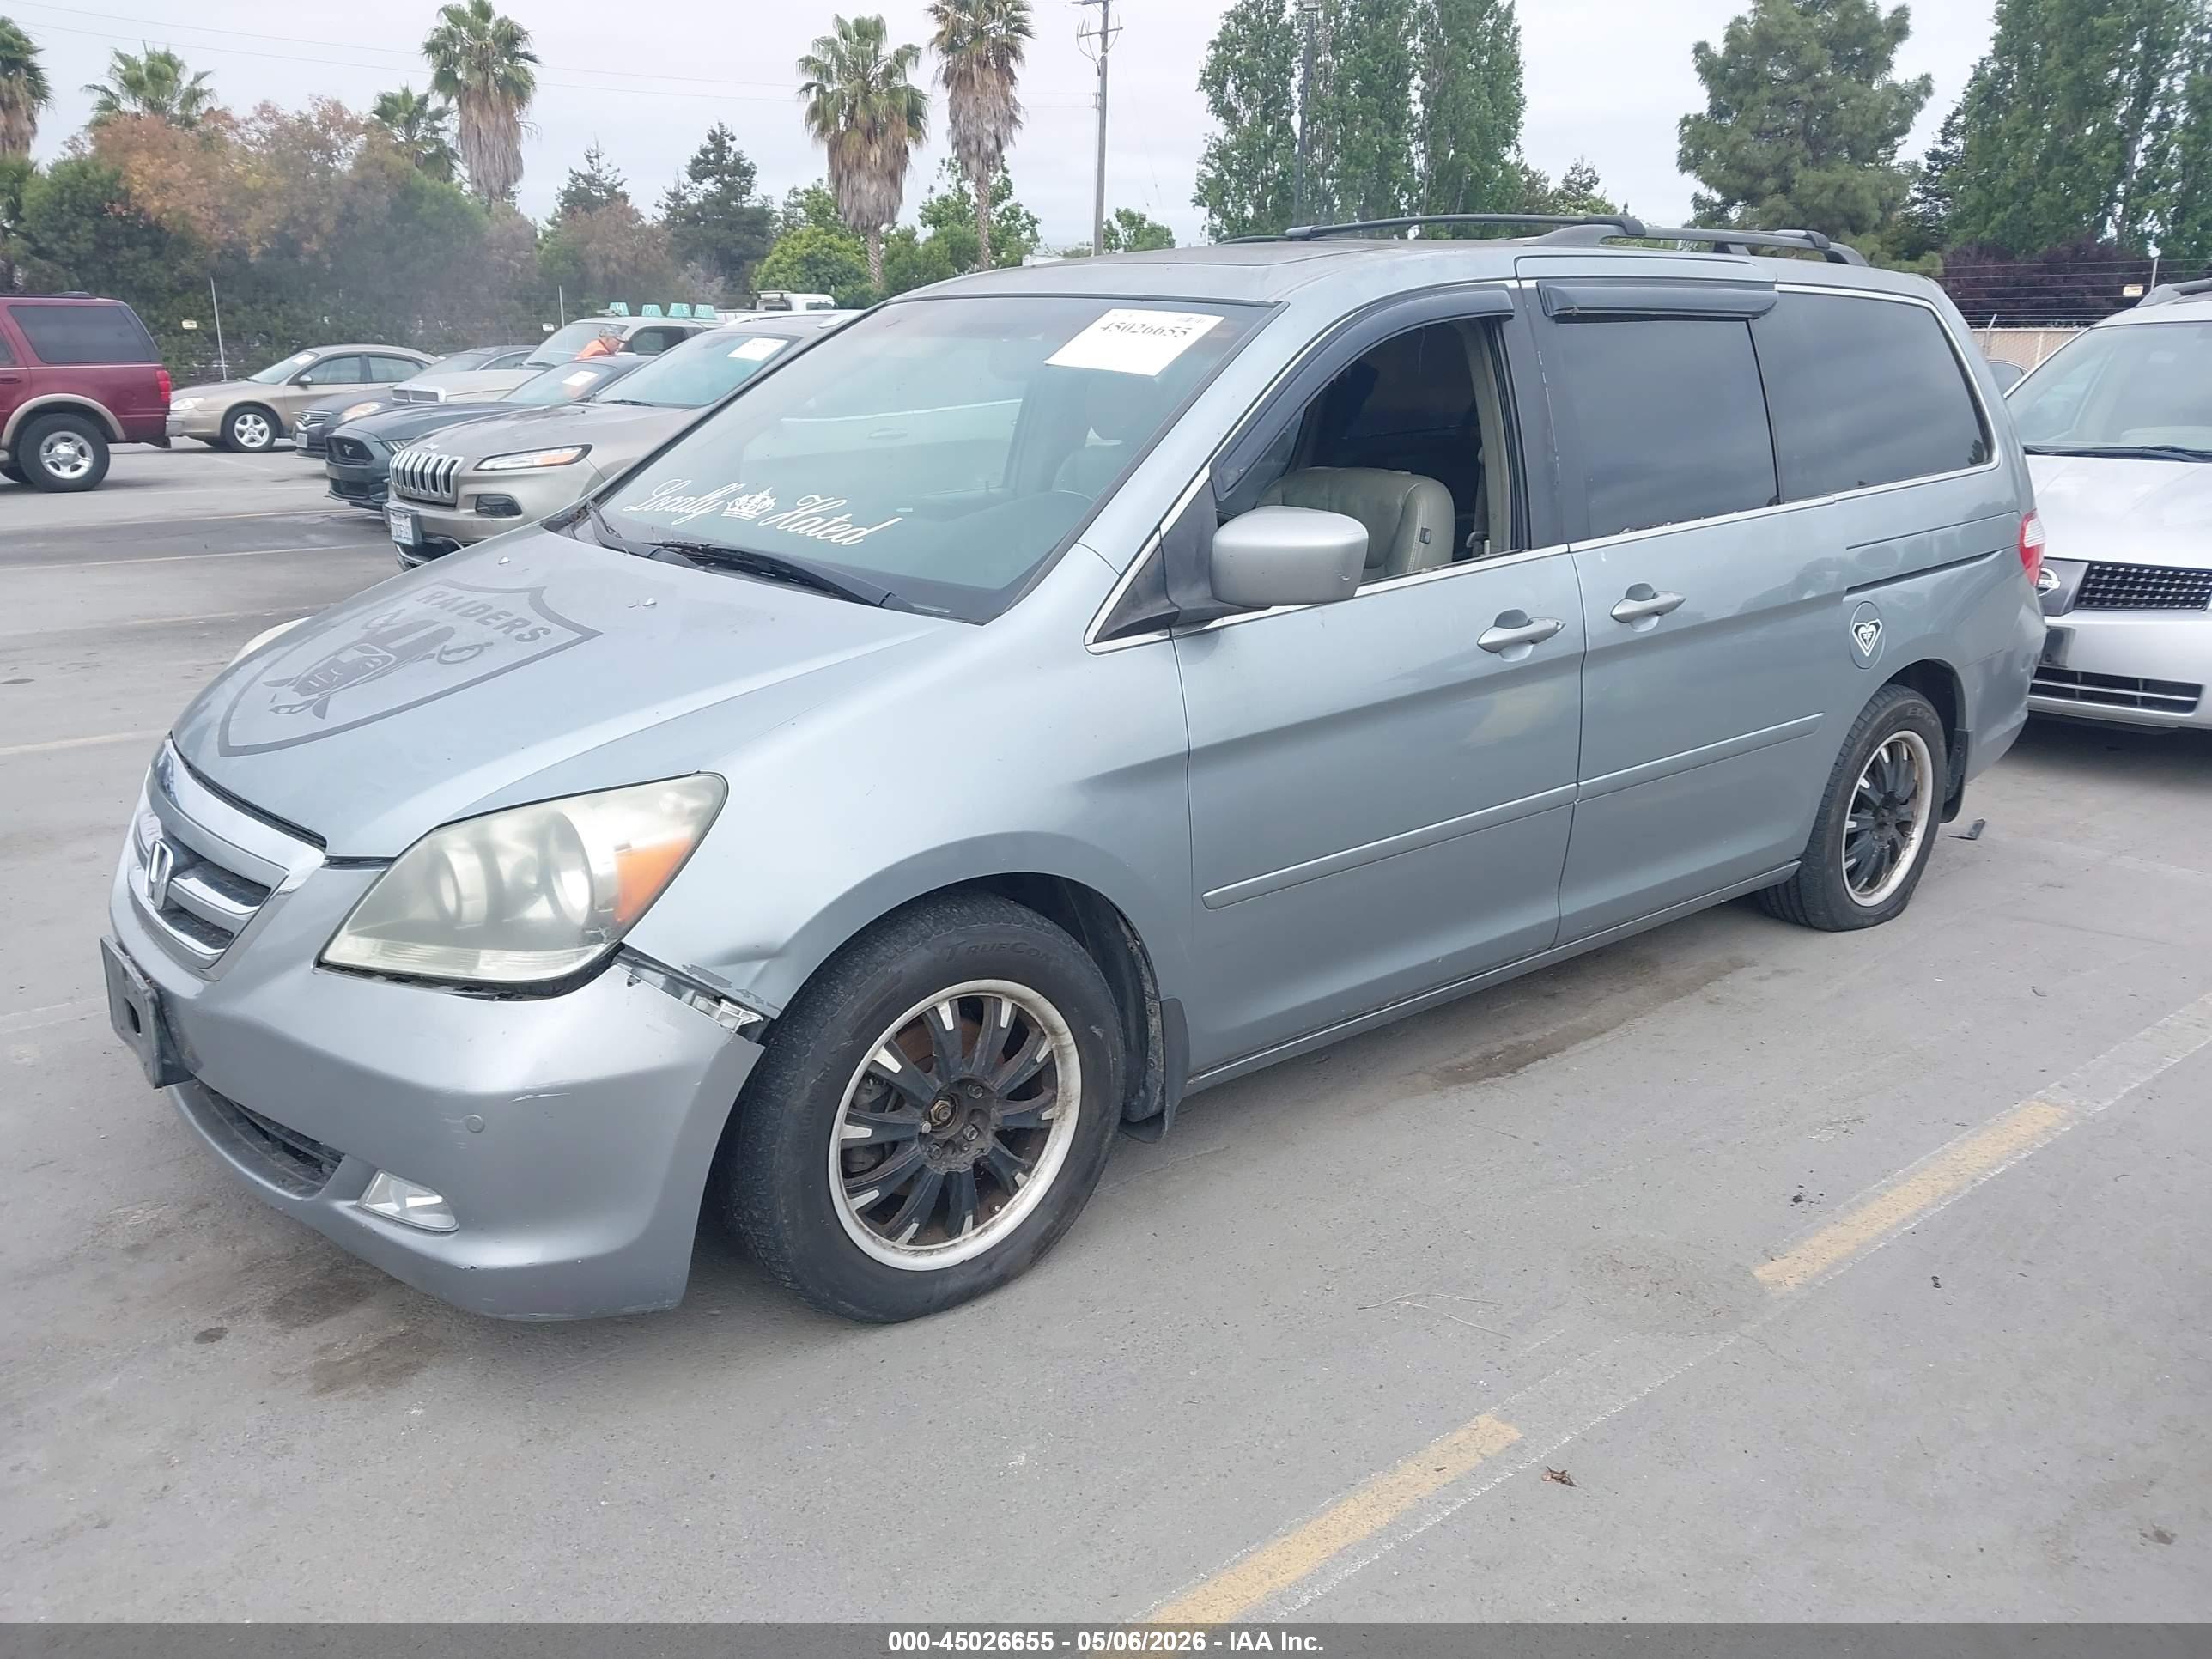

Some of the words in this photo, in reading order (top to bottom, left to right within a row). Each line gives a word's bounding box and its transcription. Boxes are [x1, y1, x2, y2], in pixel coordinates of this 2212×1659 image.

[1100, 321, 1193, 337] 45026655
[622, 478, 746, 526] Locally
[757, 495, 903, 546] Hated
[416, 590, 551, 643] RAIDERS
